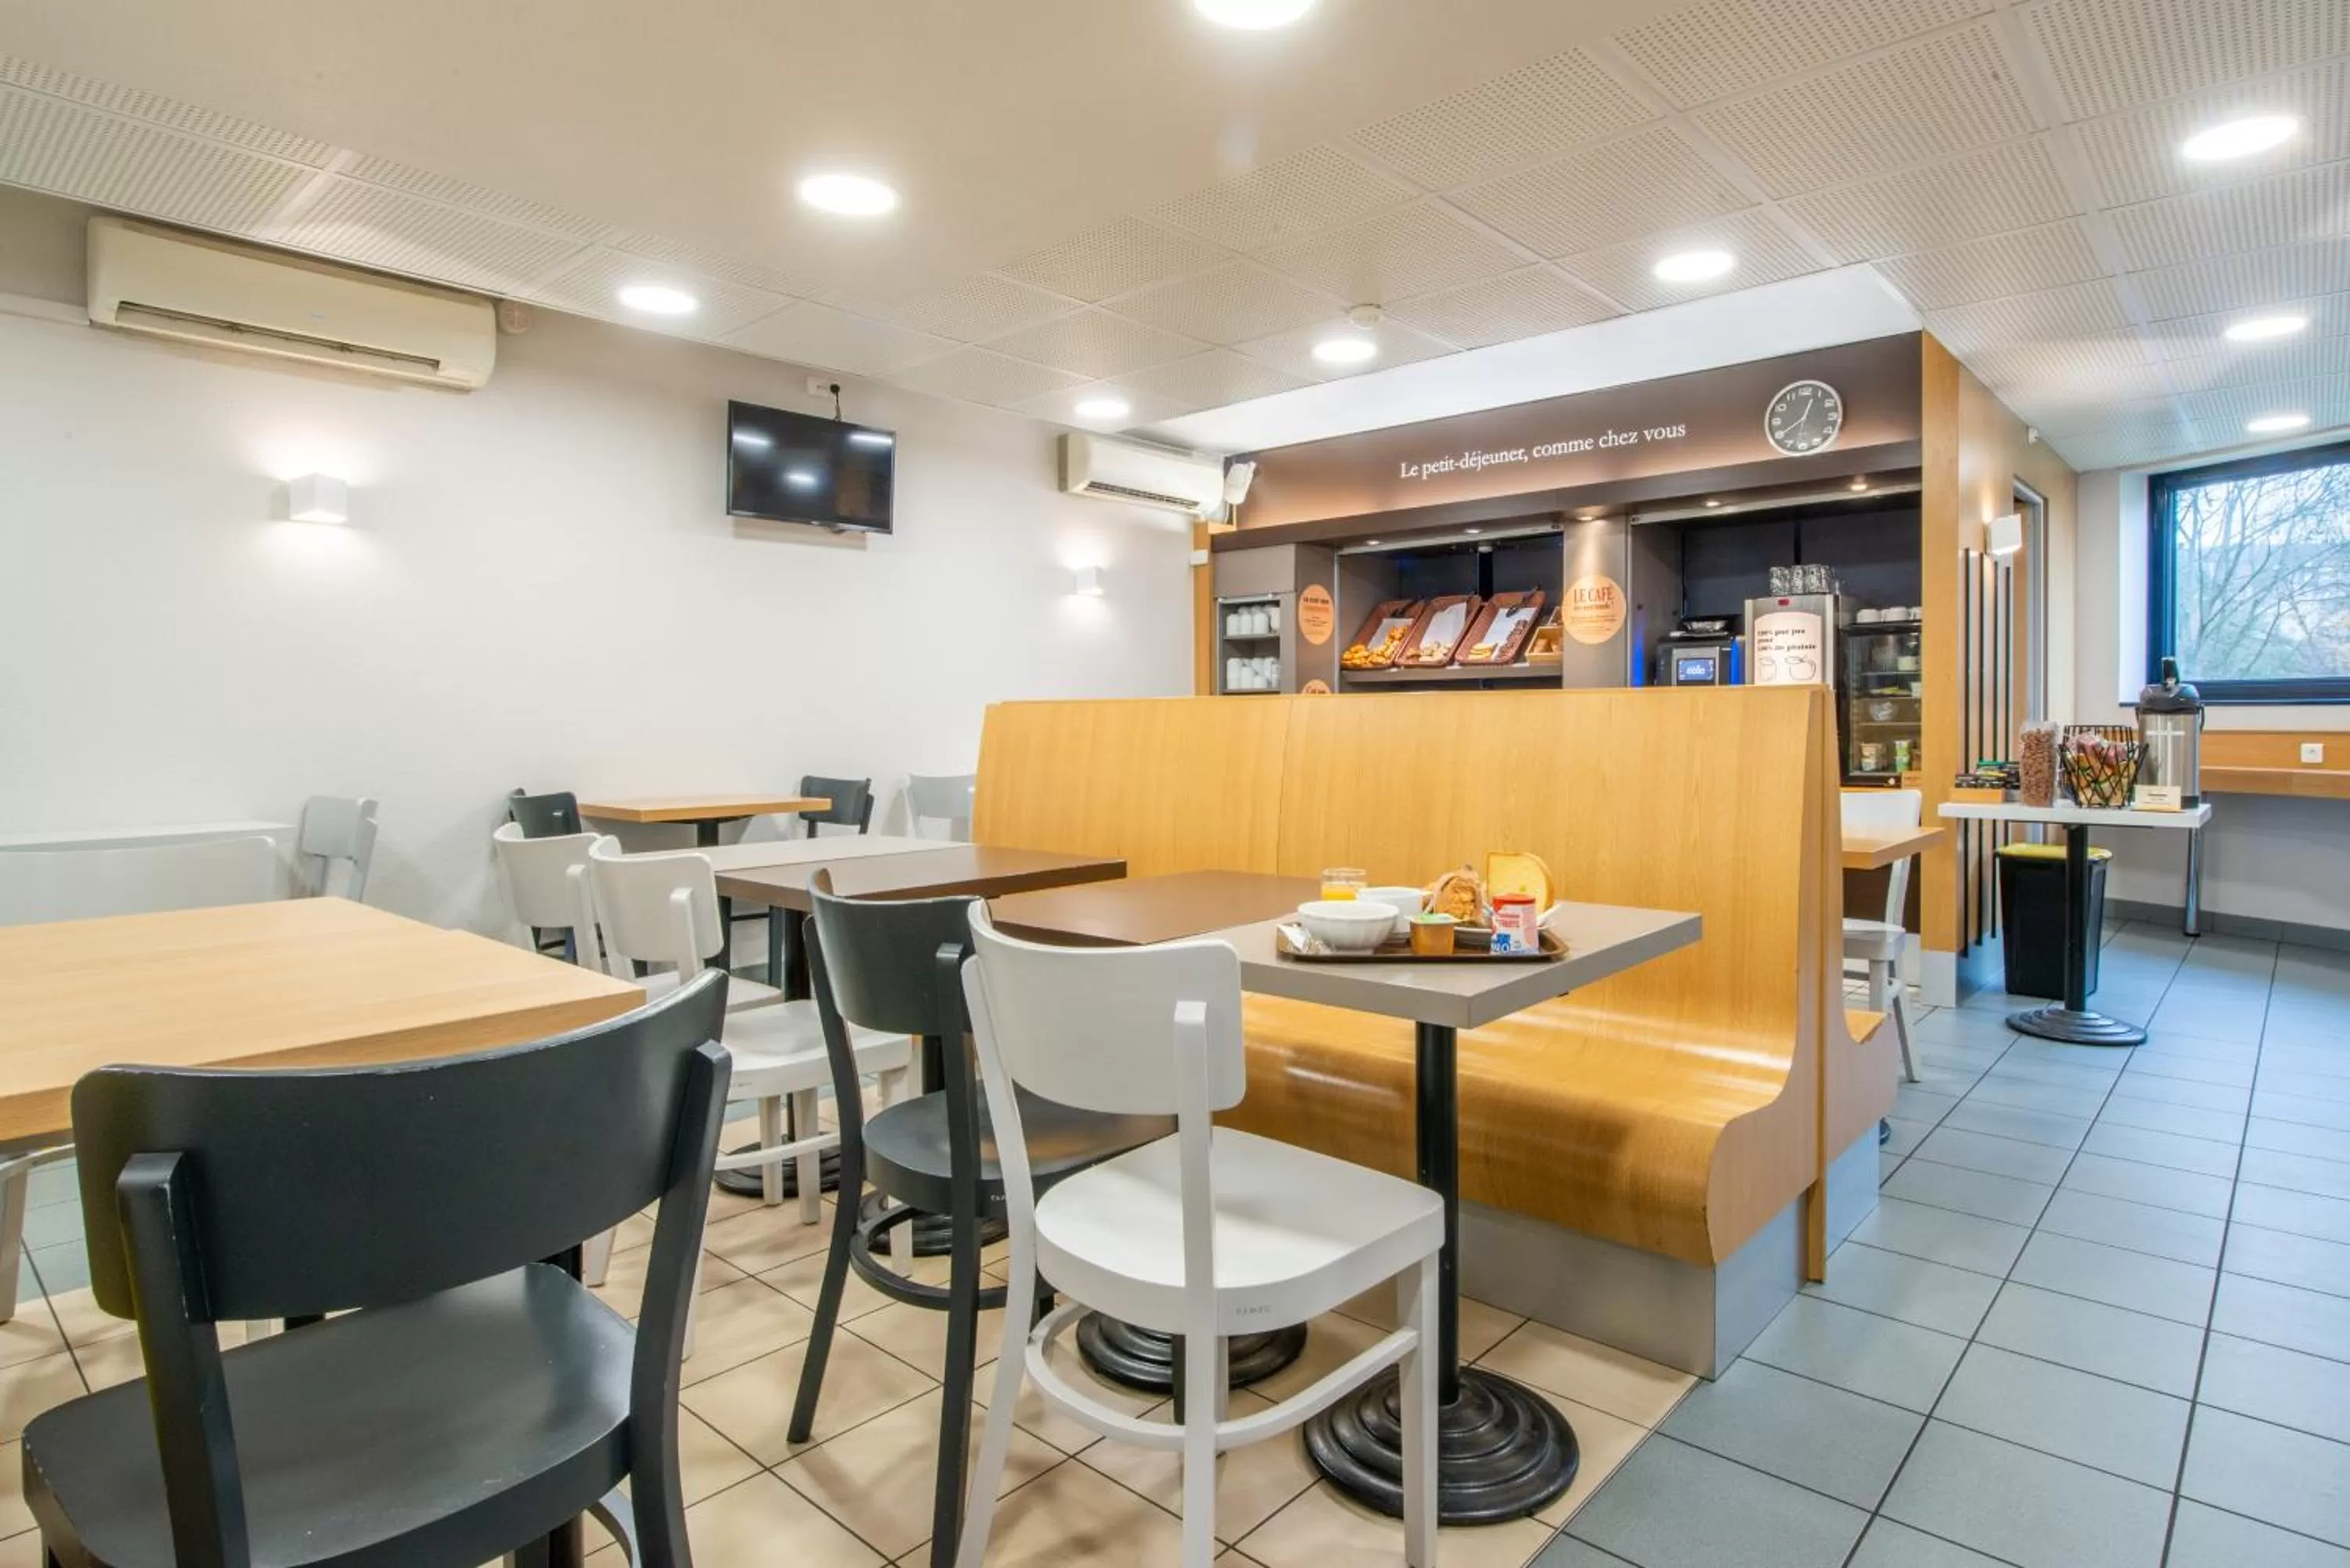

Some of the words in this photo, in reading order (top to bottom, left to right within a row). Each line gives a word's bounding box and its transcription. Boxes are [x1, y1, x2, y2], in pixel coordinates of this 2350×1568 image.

[1400, 462, 1419, 479] Le
[1422, 447, 1528, 480] petit-déjeuner,
[1533, 436, 1594, 458] comme
[1599, 430, 1638, 449] chez
[1643, 423, 1686, 442] vous
[1574, 588, 1585, 602] LE
